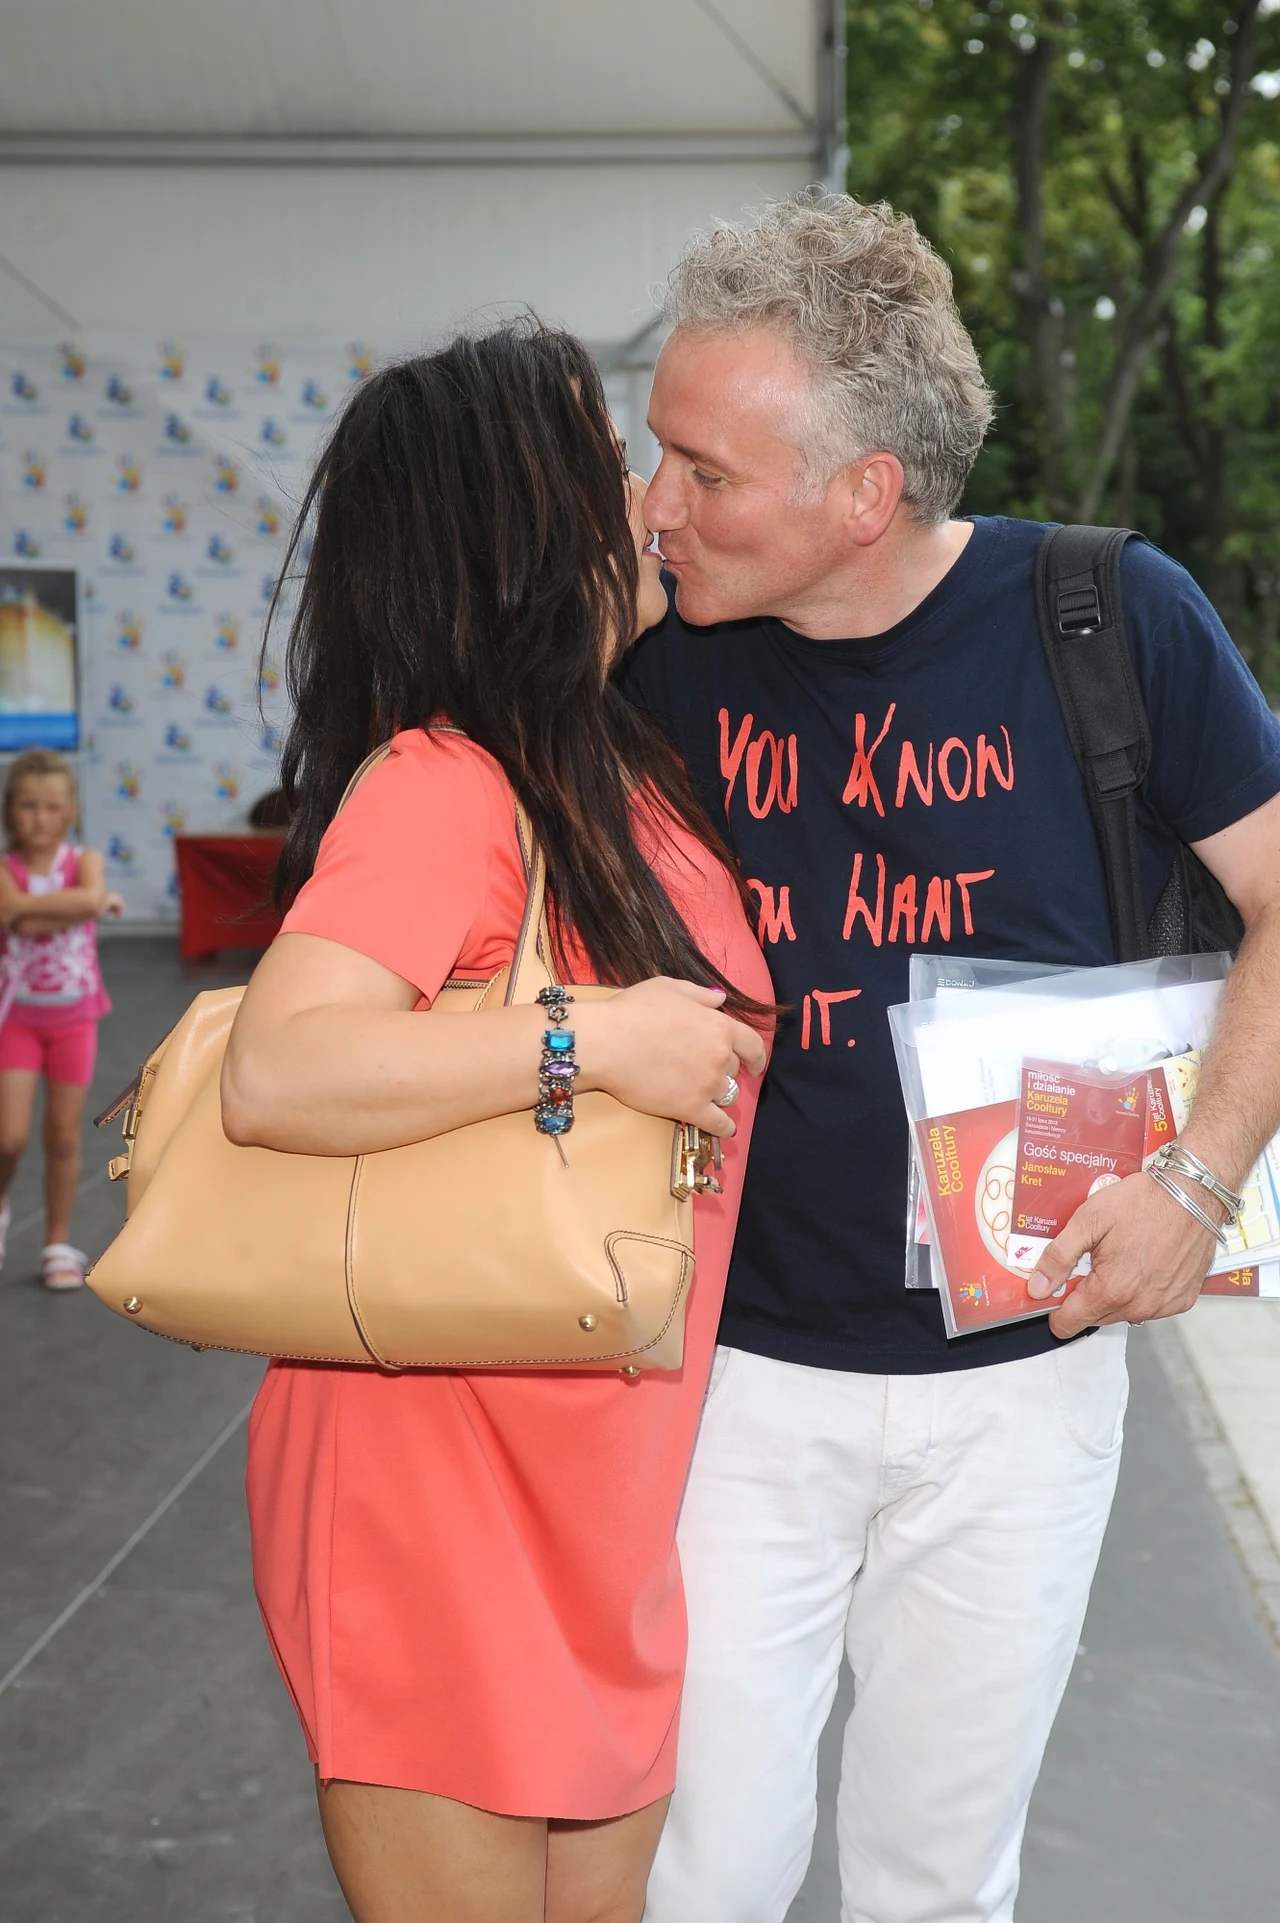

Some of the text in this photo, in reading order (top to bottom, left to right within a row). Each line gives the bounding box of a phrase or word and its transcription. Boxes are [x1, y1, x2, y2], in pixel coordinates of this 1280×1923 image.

[718, 703, 1015, 830] YOU KNOW
[842, 853, 995, 947] WANT
[801, 989, 862, 1050] IT.
[1027, 1080, 1076, 1096] i działanie
[1027, 1090, 1068, 1105] Karuzela
[1154, 1087, 1166, 1121] Cooltury
[1026, 1100, 1068, 1117] Cooltury
[1154, 1120, 1168, 1132] 5
[928, 1127, 951, 1197] Karuzela
[942, 1125, 964, 1193] Cooltury
[1024, 1141, 1118, 1171] Gość specjalny
[1022, 1161, 1067, 1176] Jarosław
[1021, 1174, 1043, 1186] Kret
[1017, 1214, 1026, 1228] 5
[1025, 1221, 1050, 1233] Cooltury
